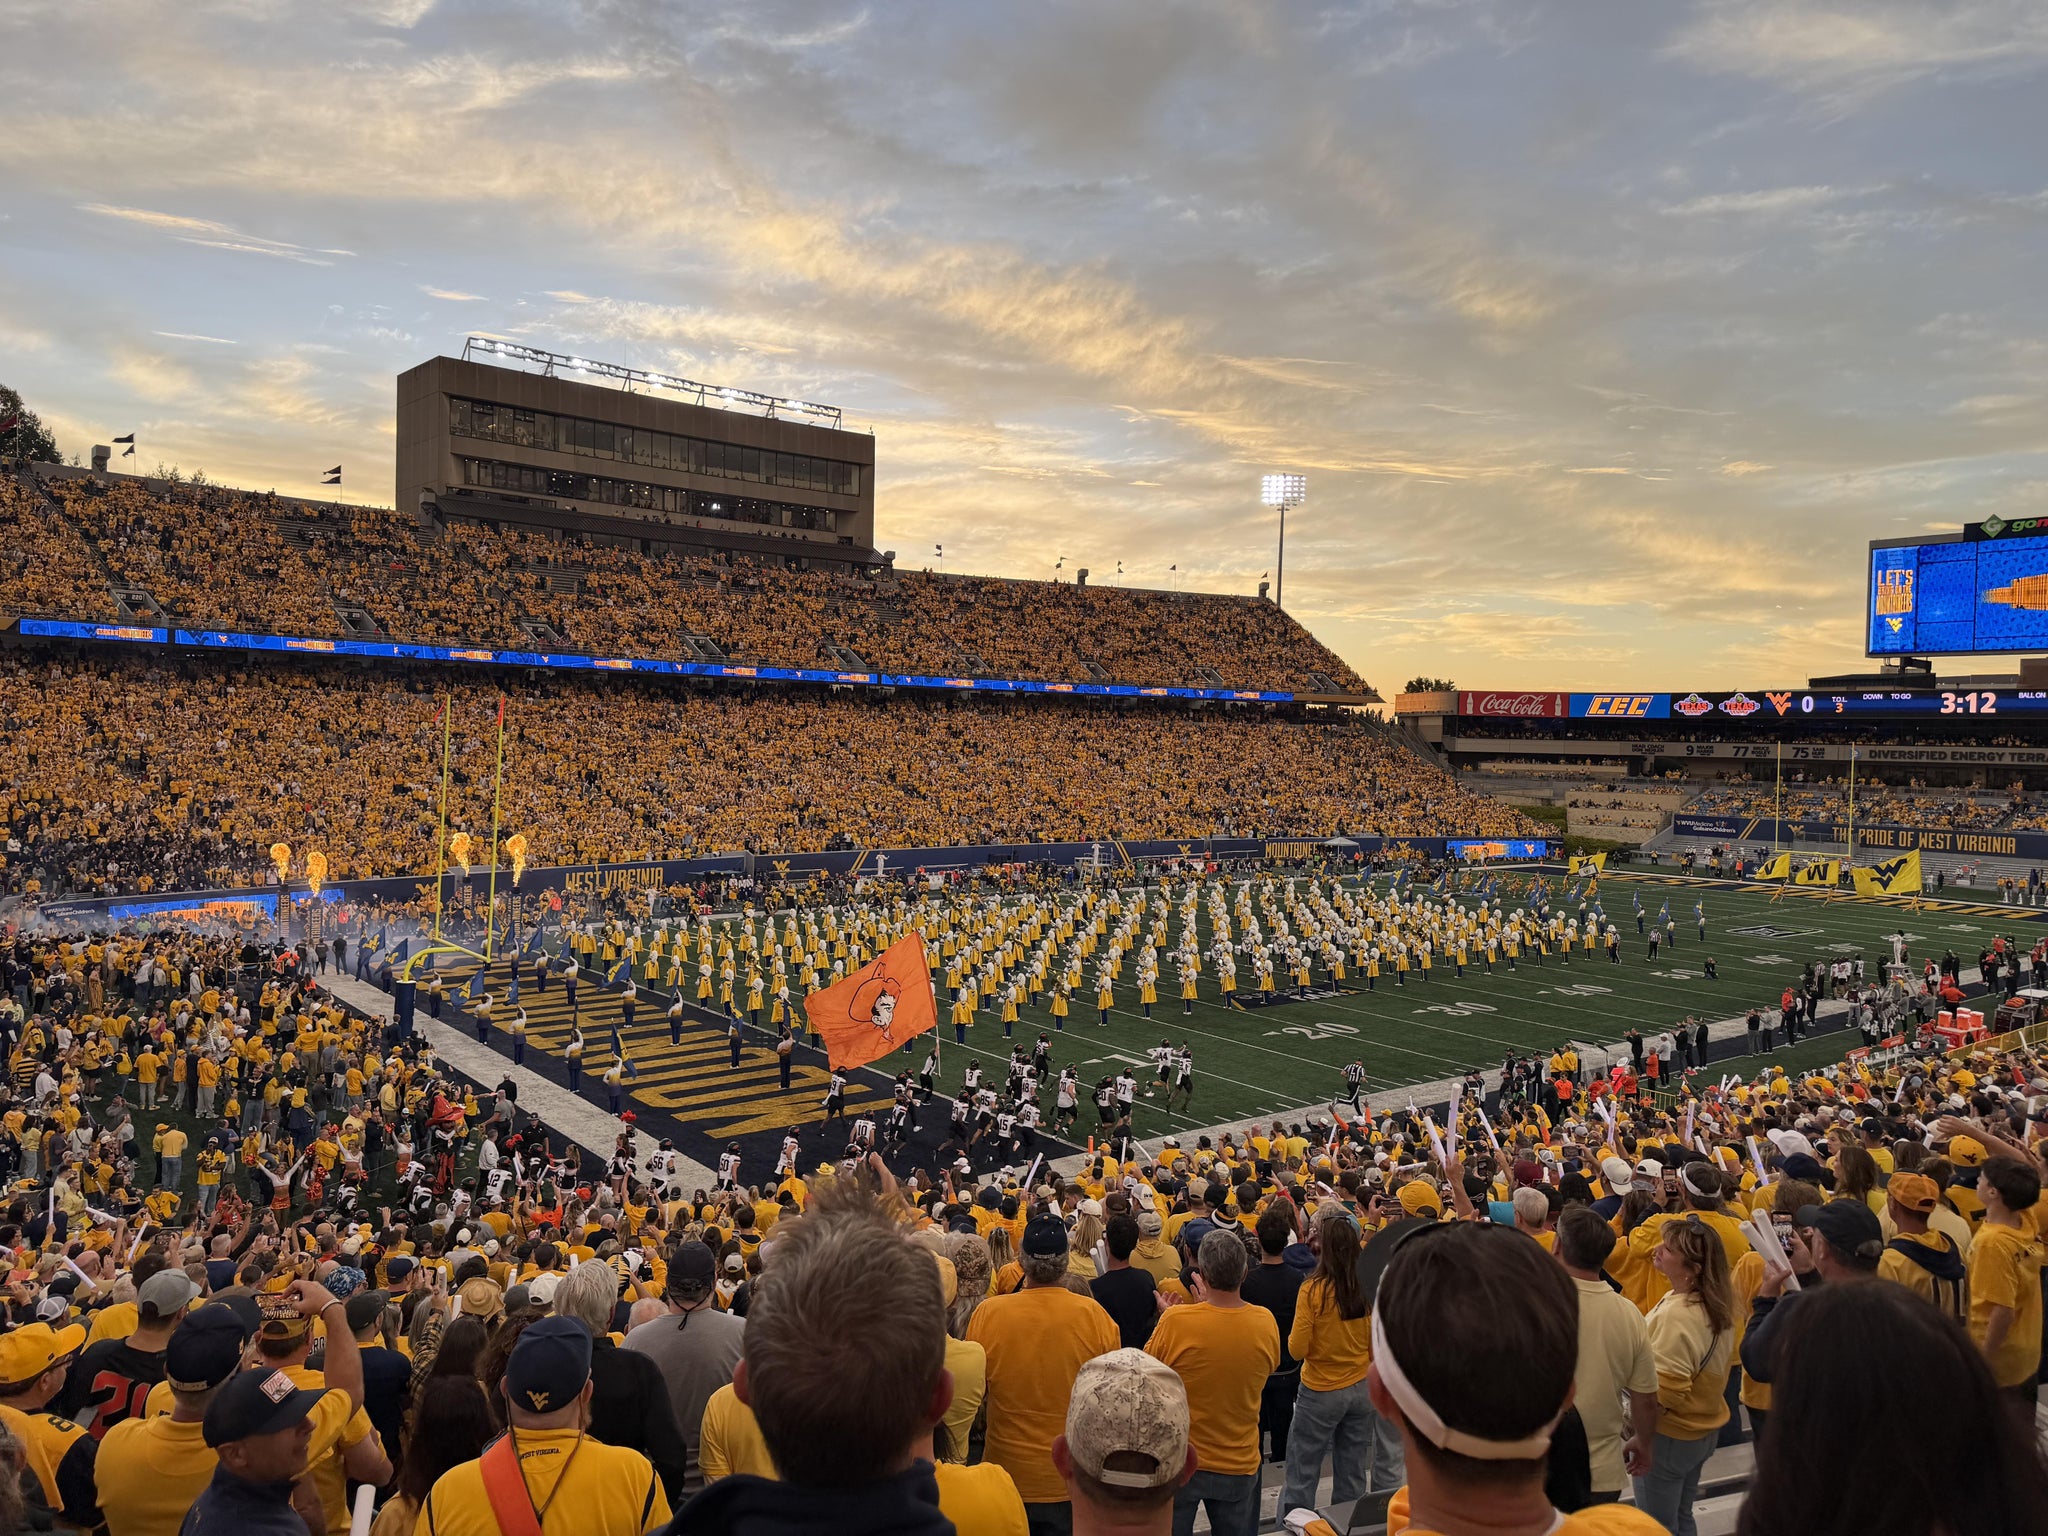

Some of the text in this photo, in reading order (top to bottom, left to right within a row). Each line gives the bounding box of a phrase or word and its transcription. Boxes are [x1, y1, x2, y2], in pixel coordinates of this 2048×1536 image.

[1877, 569, 1913, 586] LET'S
[1479, 693, 1545, 716] Coca-Cola
[1588, 696, 1652, 716] CEC
[1679, 702, 1709, 711] TEXAS
[1725, 702, 1755, 711] TEXAS
[1801, 695, 1814, 713] 0
[1835, 703, 1844, 713] 3
[1940, 692, 1997, 714] 3:12
[1686, 745, 1695, 756] 9
[1732, 746, 1749, 757] 77
[1792, 747, 1809, 758] 75
[1868, 749, 1947, 761] DIVERSIFIED
[1951, 751, 2006, 762] ENERGY
[1858, 828, 1894, 846] PRIDE
[1899, 831, 1914, 848] OF
[1918, 832, 1952, 850] WEST
[1956, 834, 2016, 854] VIRGINIA
[565, 867, 664, 895] WEST VIRGINIA
[1553, 984, 1613, 996] 40
[1427, 1001, 1498, 1016] 30
[1281, 1022, 1360, 1040] 20
[968, 1071, 974, 1082] 3
[1118, 1083, 1127, 1095] 77
[981, 1095, 991, 1107] 85
[857, 1125, 868, 1136] 10
[1000, 1119, 1009, 1131] 15
[653, 1156, 663, 1170] 56
[487, 1173, 501, 1187] 12
